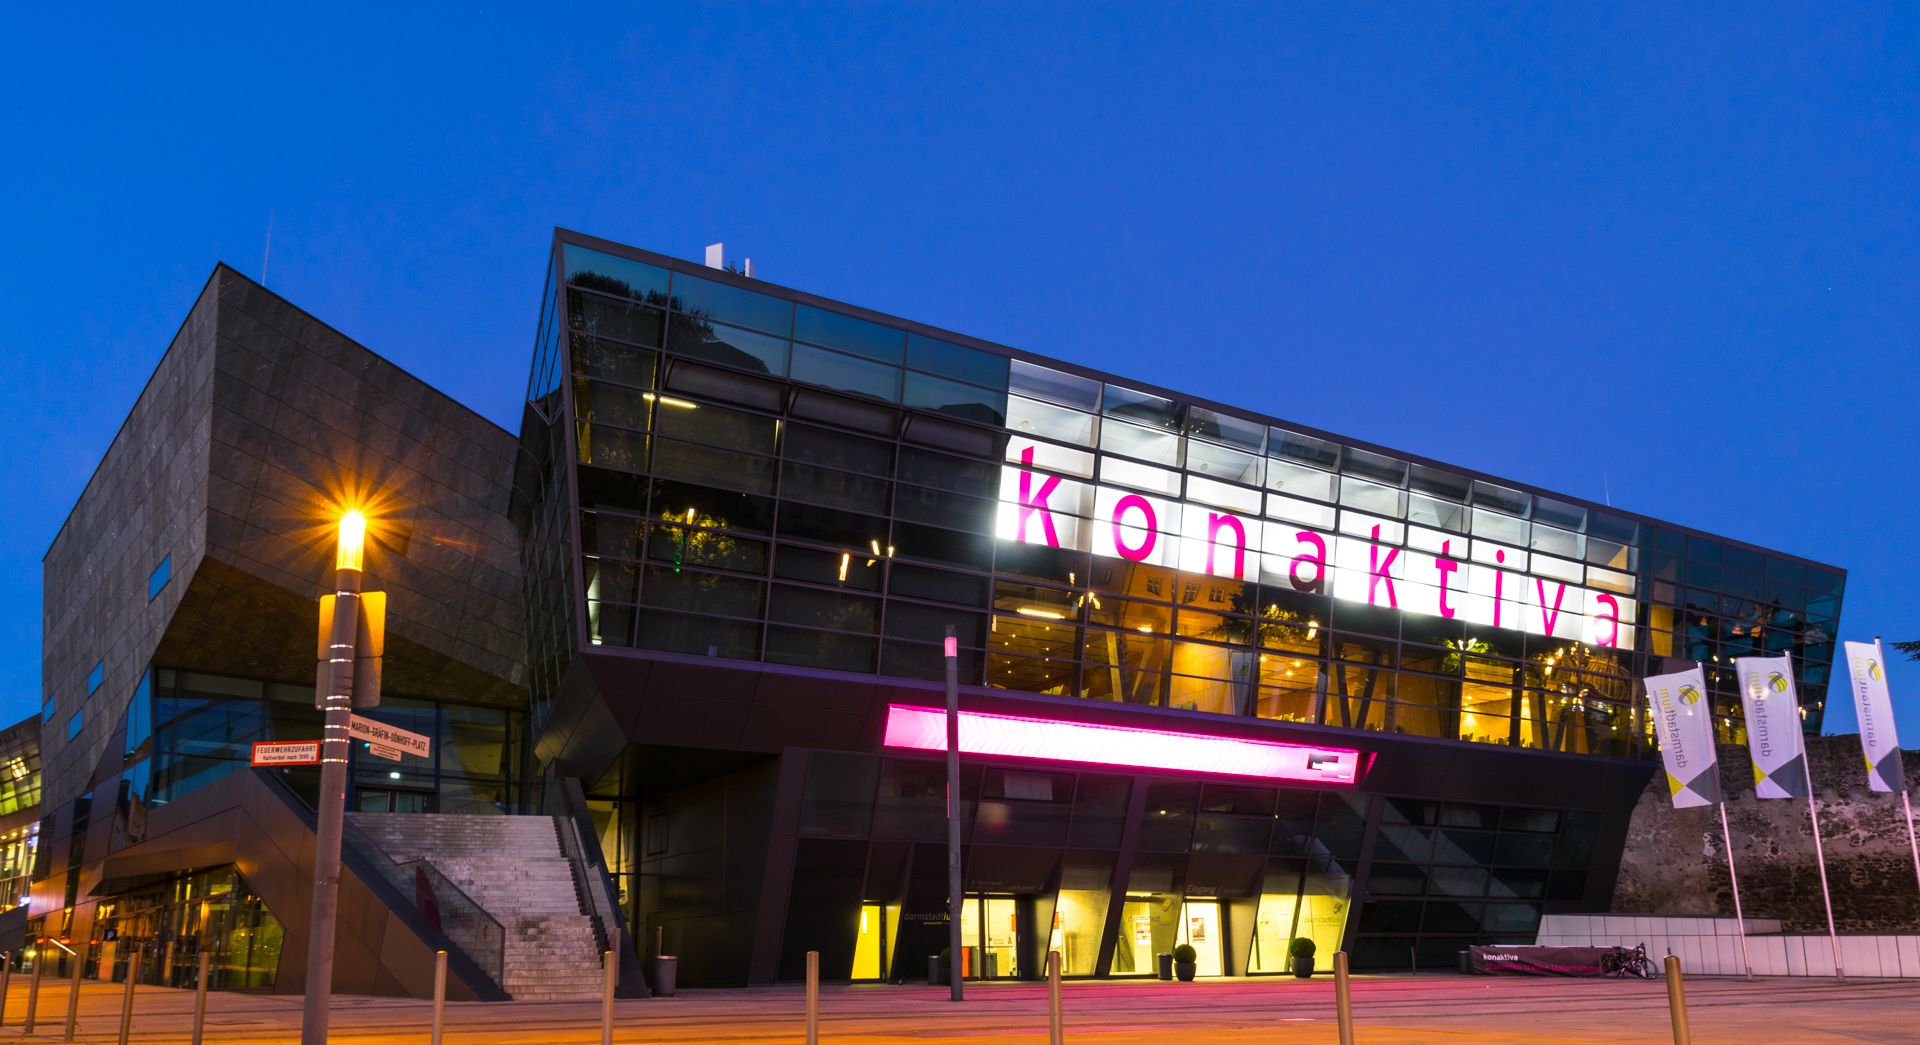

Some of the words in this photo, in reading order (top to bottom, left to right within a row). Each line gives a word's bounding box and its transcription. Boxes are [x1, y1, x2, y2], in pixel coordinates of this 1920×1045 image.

[1015, 445, 1619, 650] konaktiva
[351, 720, 426, 752] MARION-GRÄFIN-DÖNHOFF-PLATZ
[256, 745, 316, 754] FEUERWEHRZUFAHRT
[1185, 884, 1216, 895] Eingang
[1483, 953, 1518, 961] konaktiva
